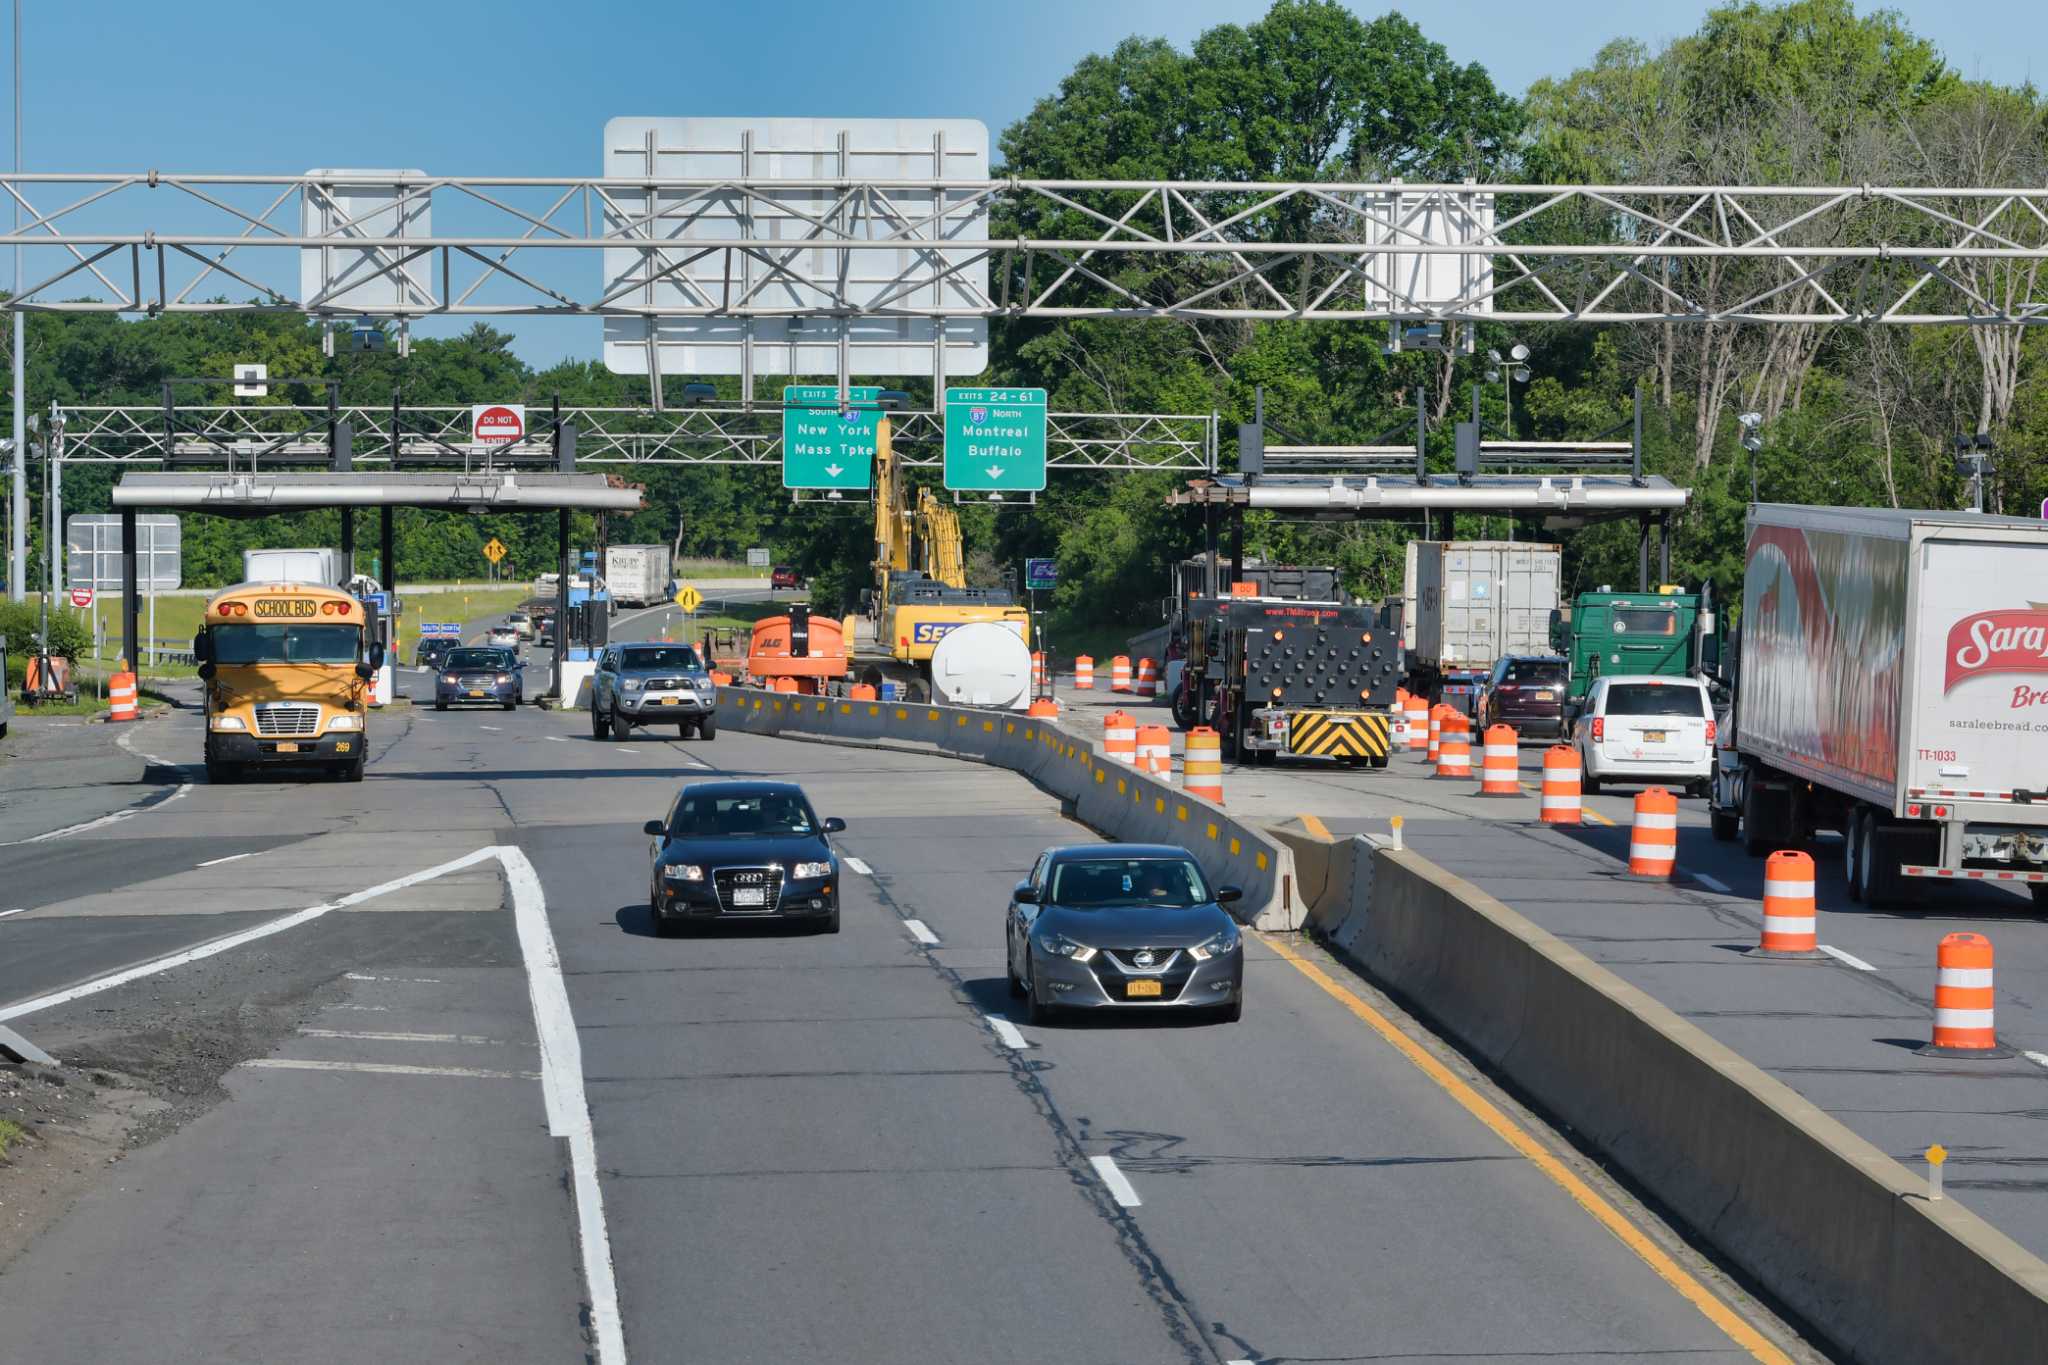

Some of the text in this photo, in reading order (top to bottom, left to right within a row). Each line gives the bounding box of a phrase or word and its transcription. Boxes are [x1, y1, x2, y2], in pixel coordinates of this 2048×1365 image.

[802, 390, 827, 398] EXITS
[959, 392, 983, 400] EXITS
[973, 411, 985, 421] 87
[992, 409, 1022, 418] NORTH
[483, 416, 512, 424] DO NOT
[798, 423, 871, 436] New York
[963, 425, 1029, 437] Montreal
[795, 443, 874, 457] Mass Tpke
[968, 445, 1022, 456] Buffalo
[257, 600, 315, 616] SCHOOL BUS
[760, 638, 783, 648] JLG
[1956, 619, 2046, 669] Sara
[1917, 749, 1956, 761] TT-1033
